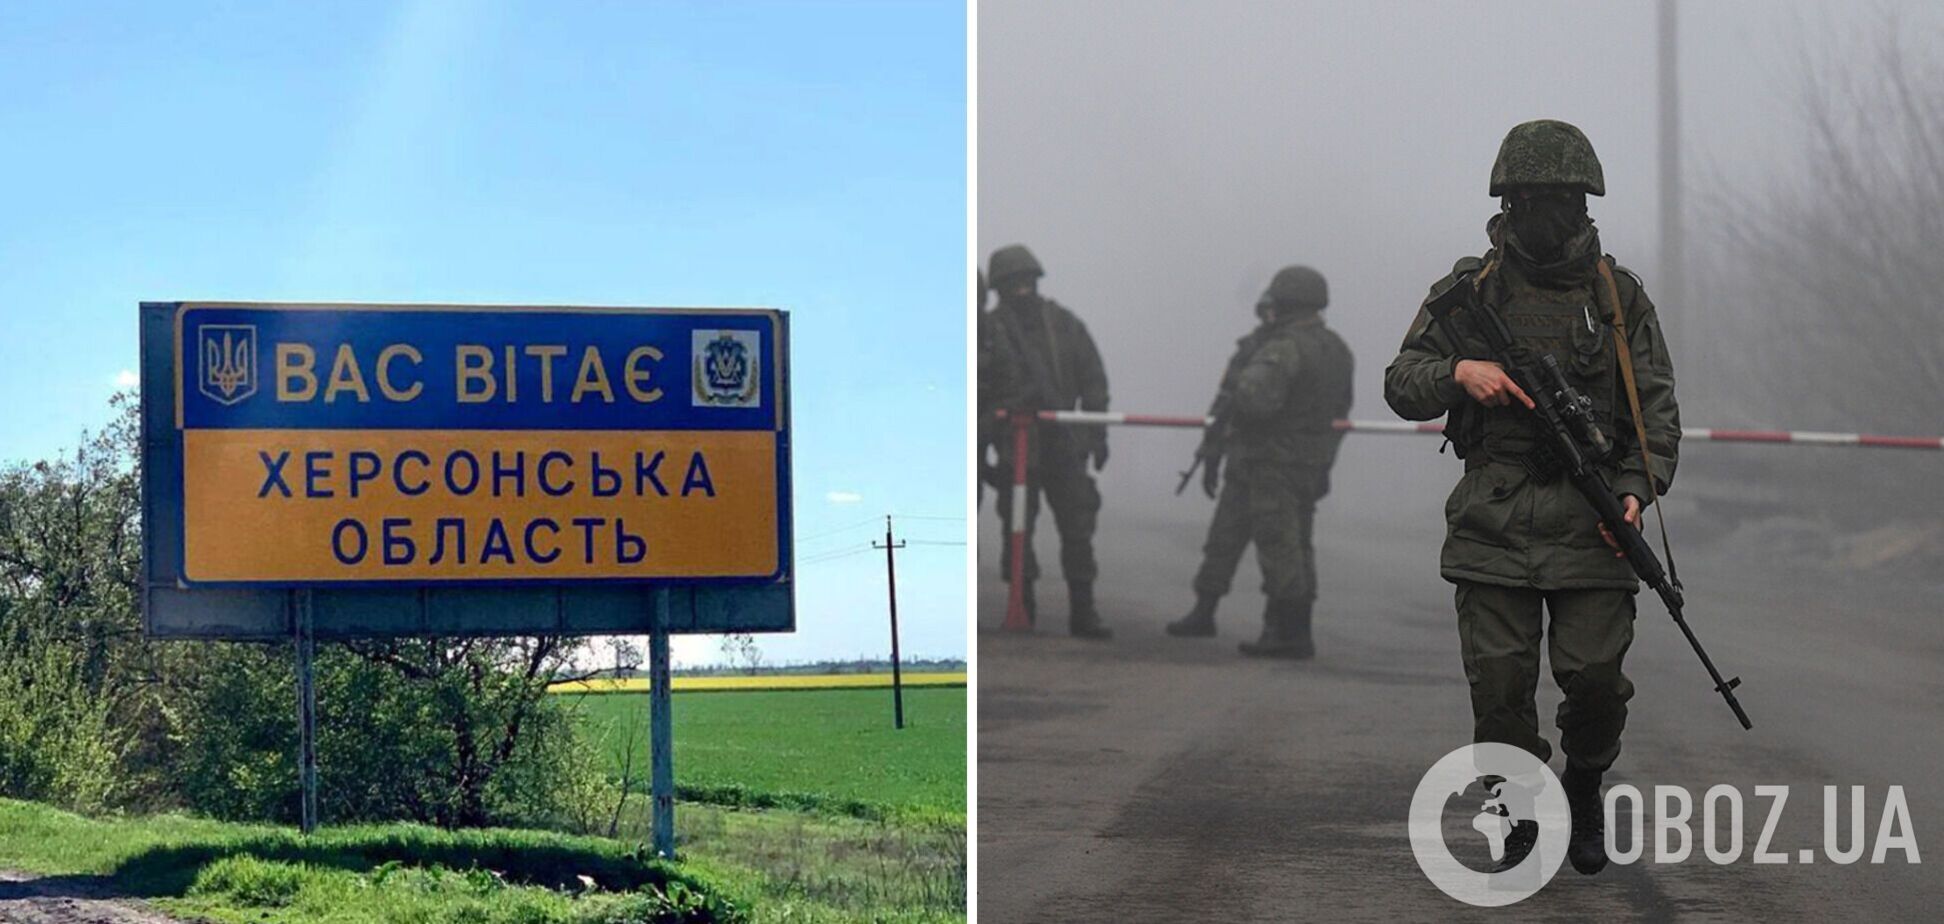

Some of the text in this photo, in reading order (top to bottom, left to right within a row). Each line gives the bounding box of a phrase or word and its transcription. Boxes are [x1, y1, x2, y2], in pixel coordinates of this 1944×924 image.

[276, 342, 664, 404] ВАС ВІТАЄ
[258, 449, 716, 498] ХЕРСОНСЬКА
[332, 518, 648, 566] ОБЛАСТЬ
